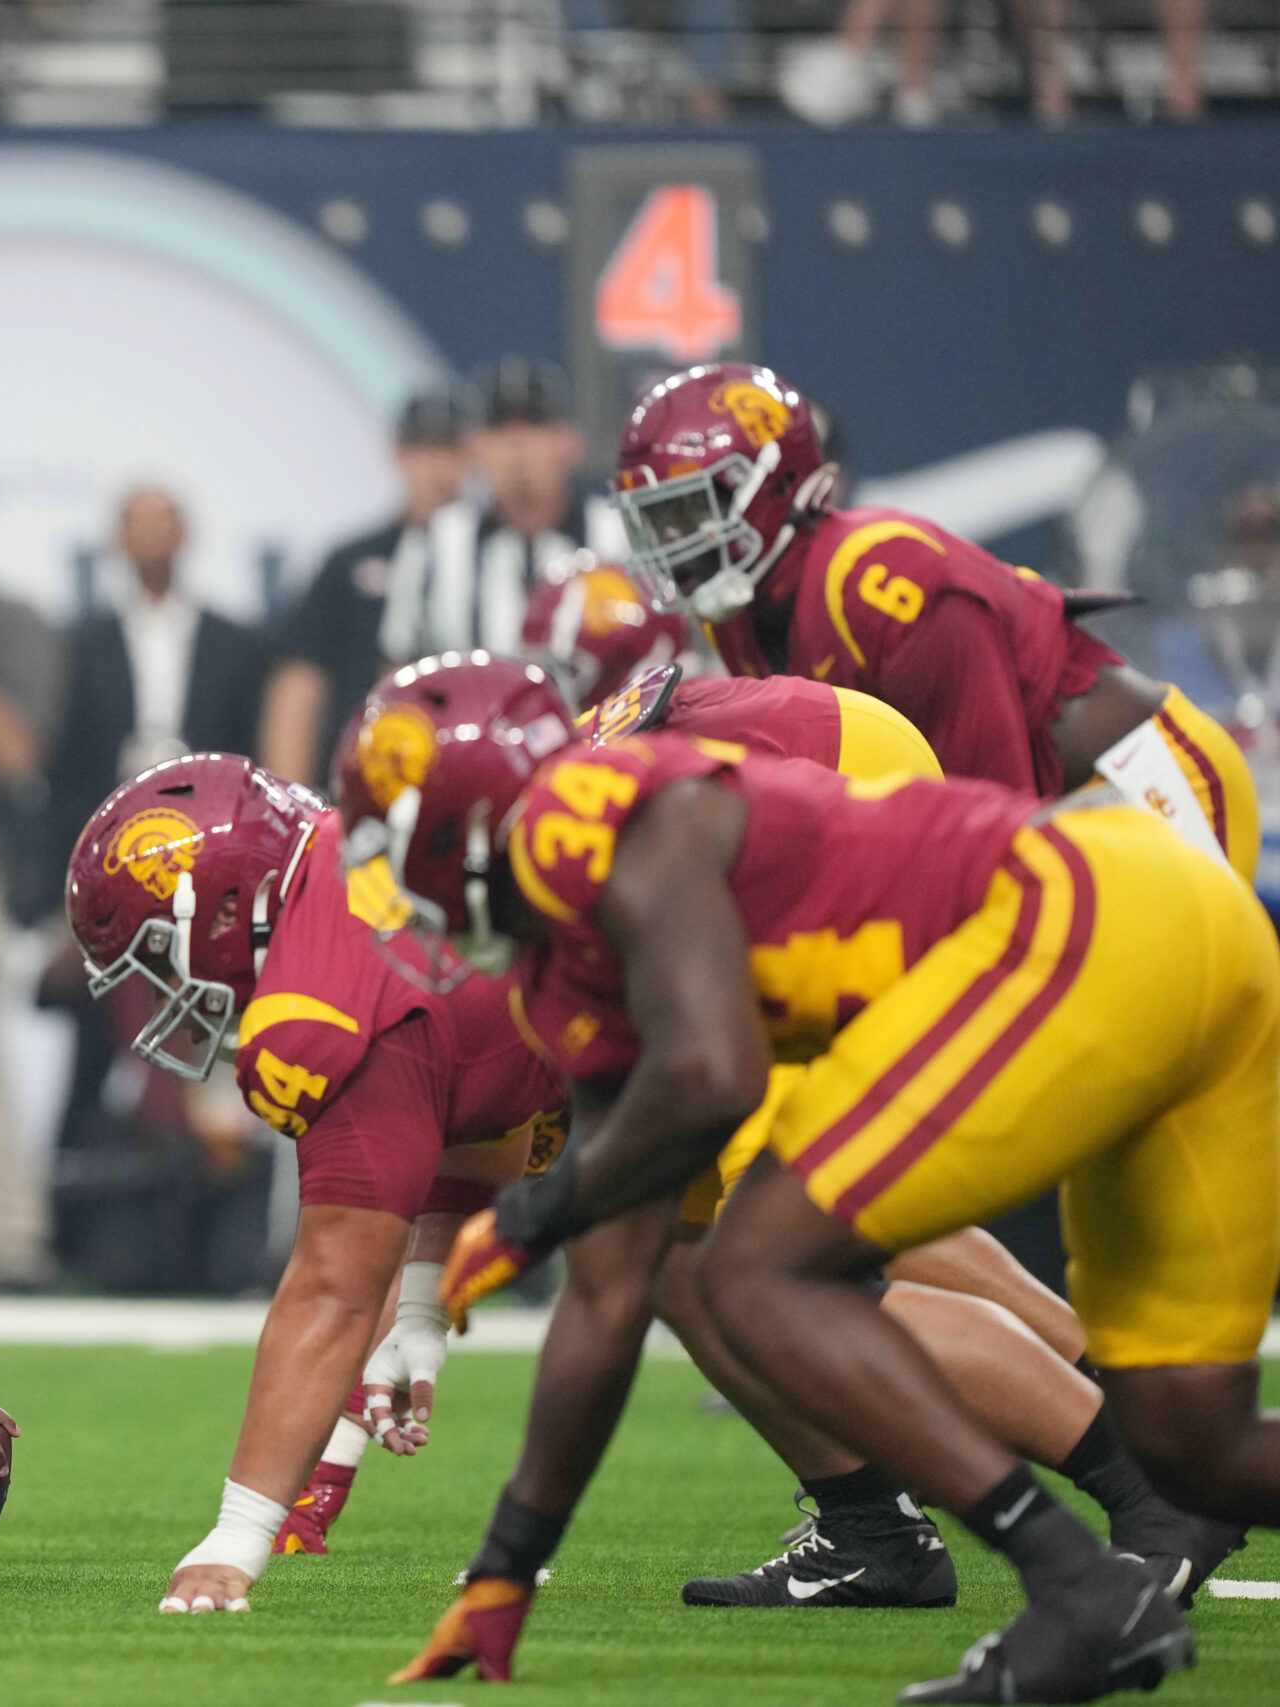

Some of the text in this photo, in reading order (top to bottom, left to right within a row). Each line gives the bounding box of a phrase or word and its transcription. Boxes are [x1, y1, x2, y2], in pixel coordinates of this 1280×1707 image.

[594, 182, 742, 360] 4
[859, 563, 924, 624] 6
[533, 760, 639, 884] 34
